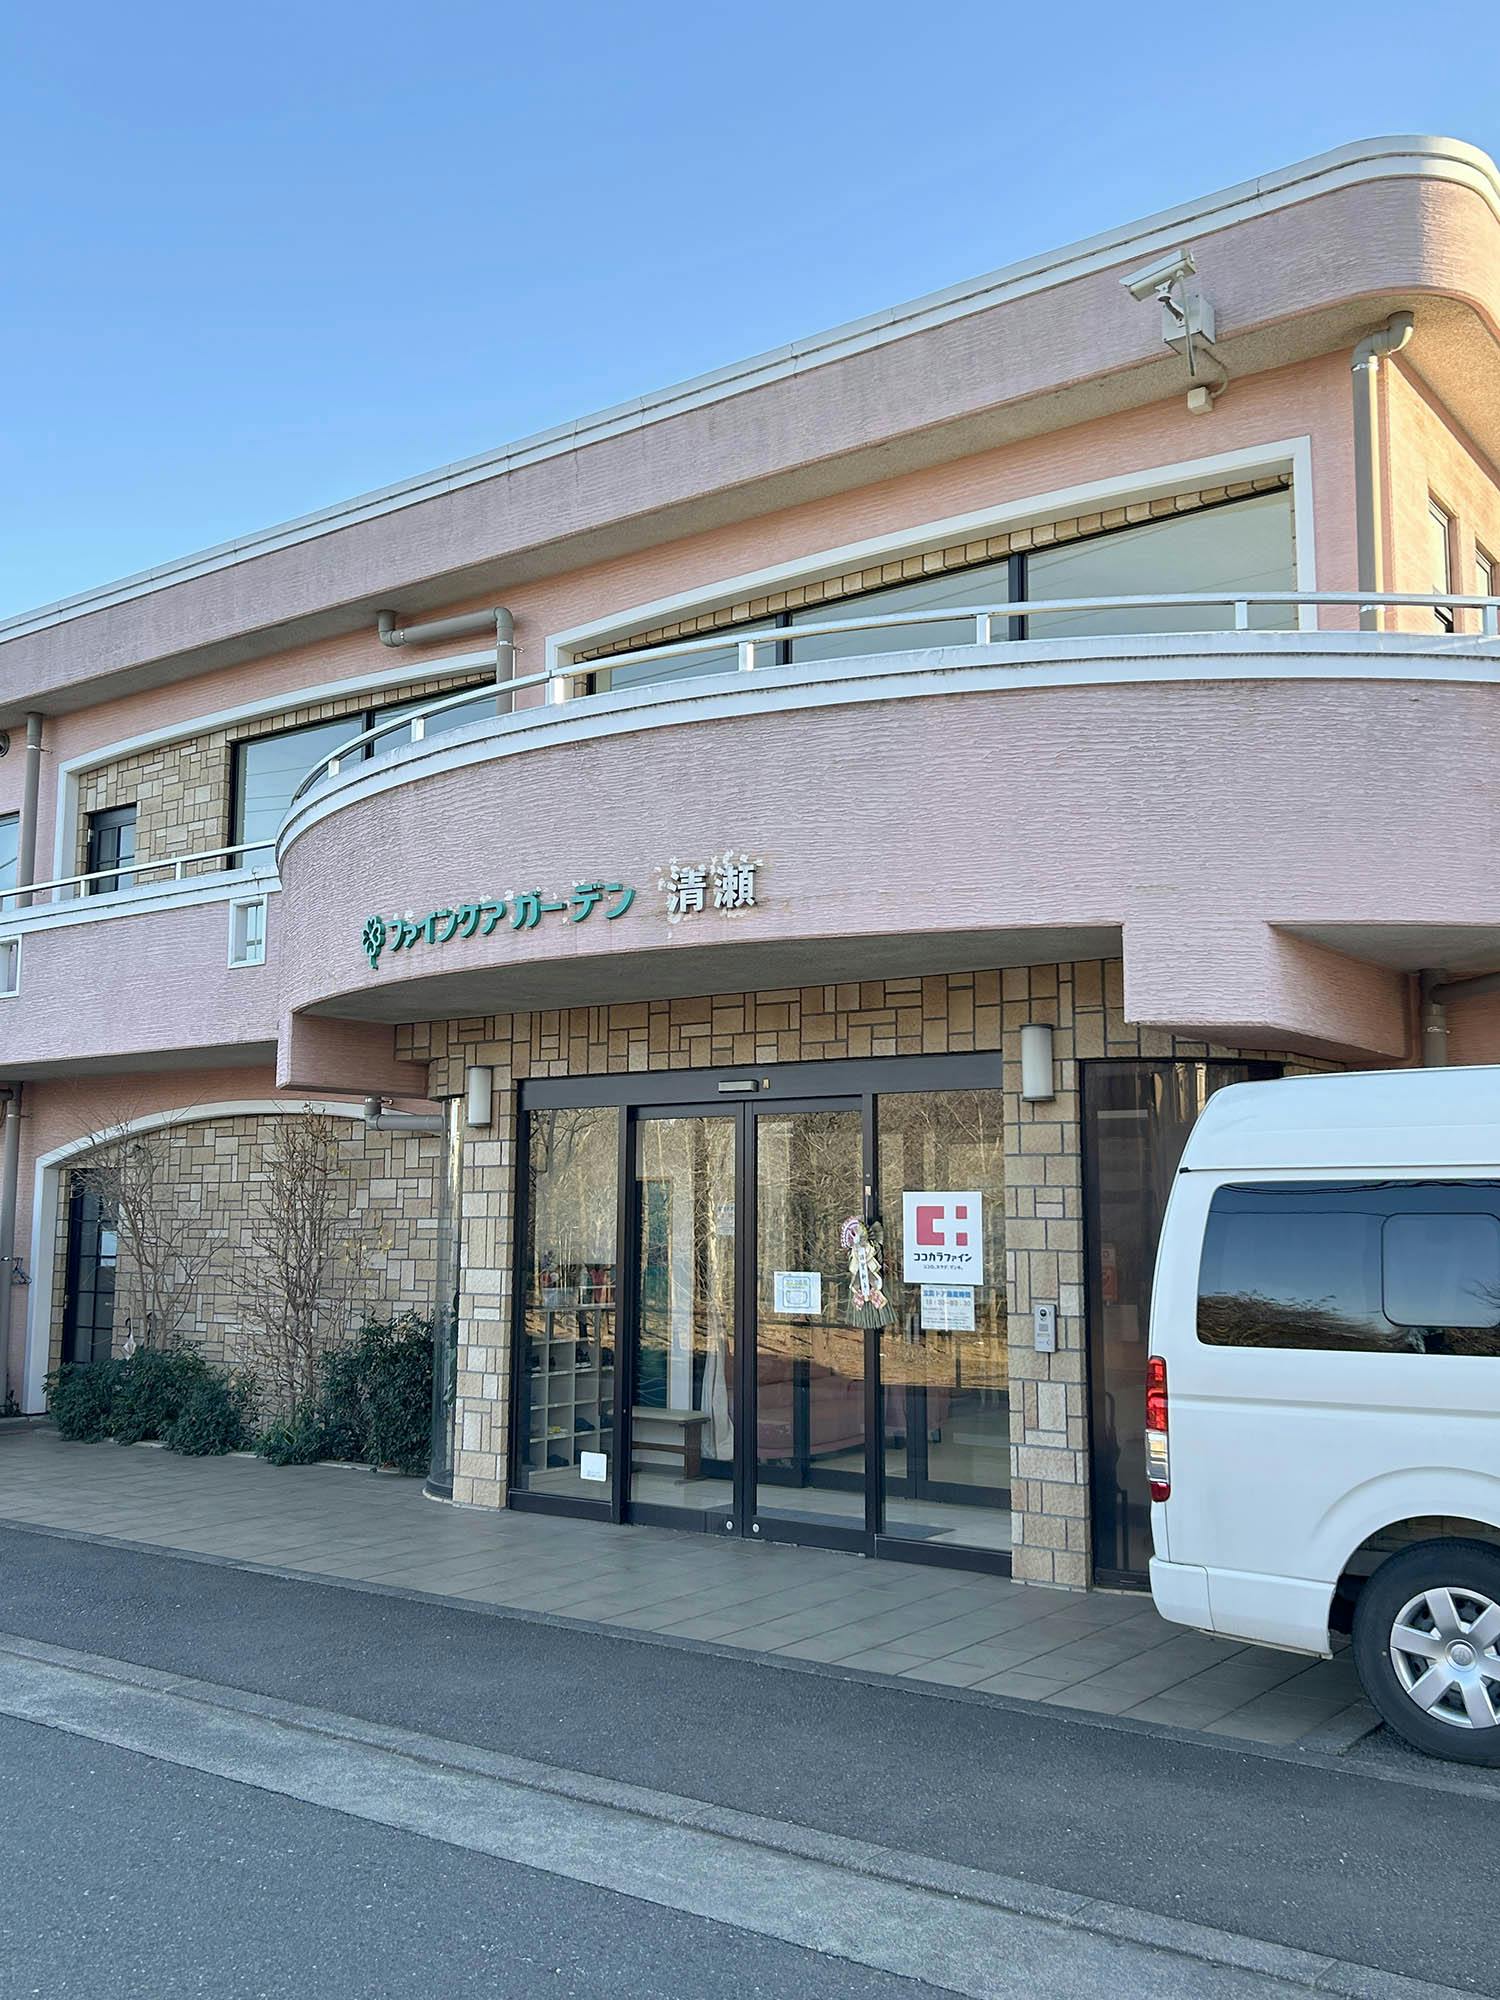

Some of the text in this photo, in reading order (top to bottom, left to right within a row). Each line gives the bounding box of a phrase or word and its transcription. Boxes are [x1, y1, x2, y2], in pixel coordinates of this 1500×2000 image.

[666, 863, 755, 914] 清瀬
[913, 1252, 973, 1263] ココカラファイン
